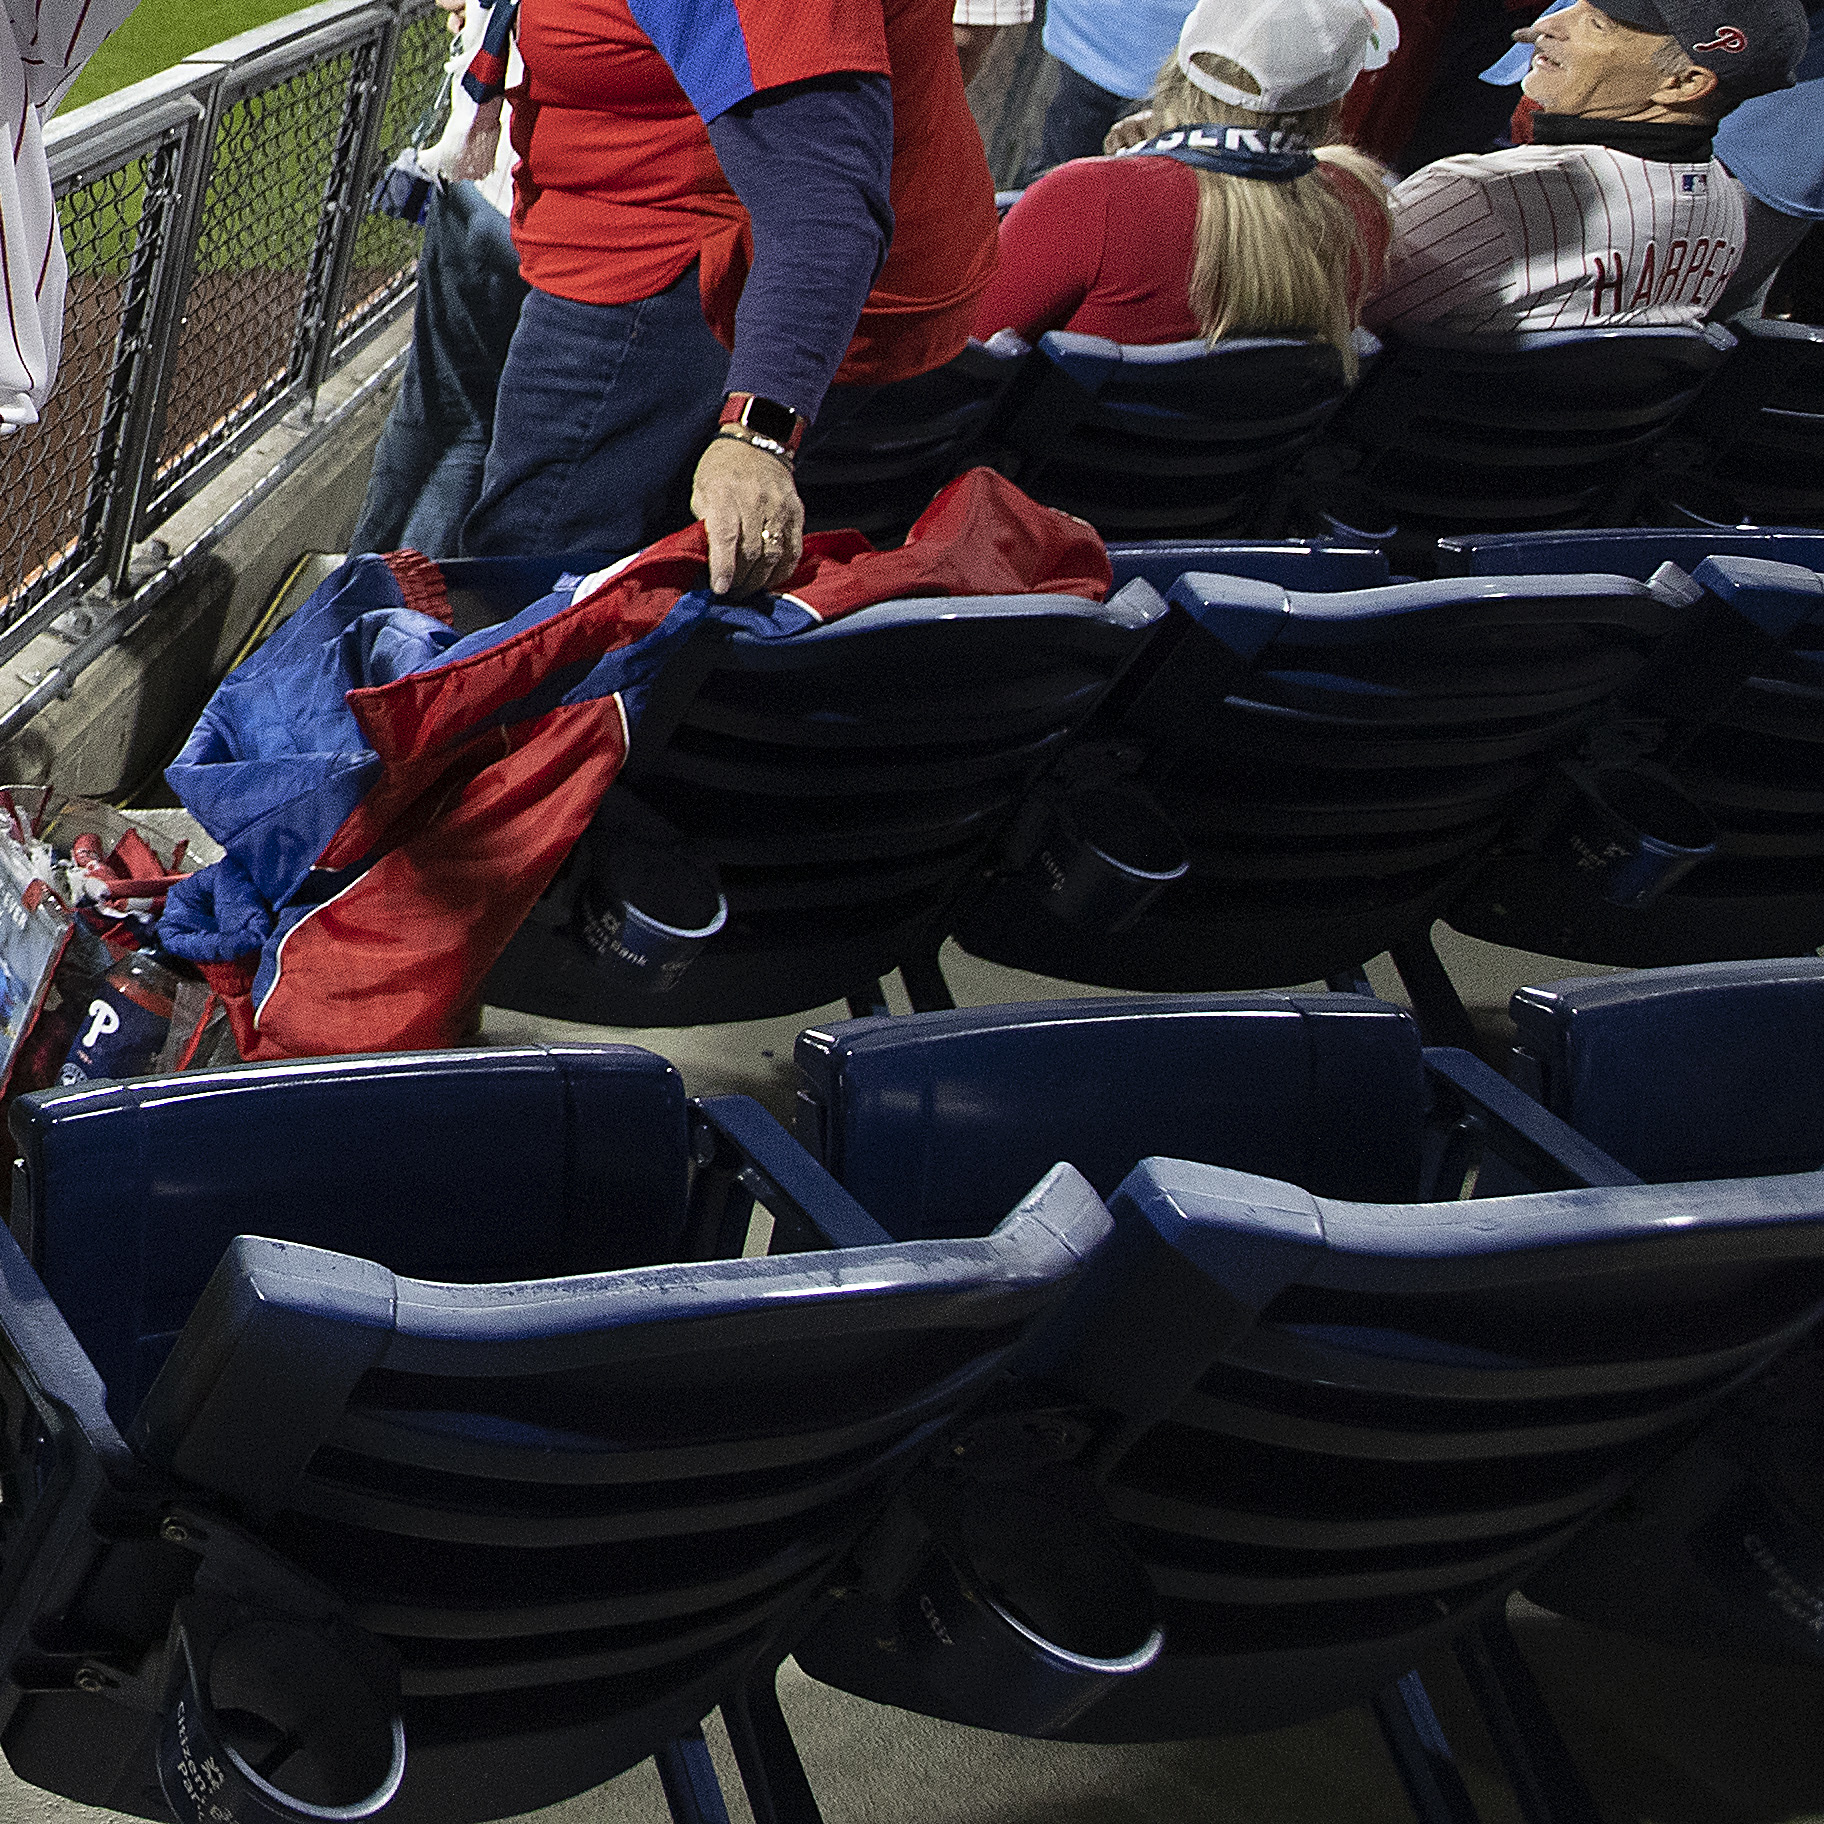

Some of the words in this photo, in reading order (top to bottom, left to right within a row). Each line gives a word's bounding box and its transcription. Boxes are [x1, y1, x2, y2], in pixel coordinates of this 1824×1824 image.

[1693, 26, 1748, 54] P
[1592, 237, 1736, 318] HARPER
[82, 998, 120, 1048] P
